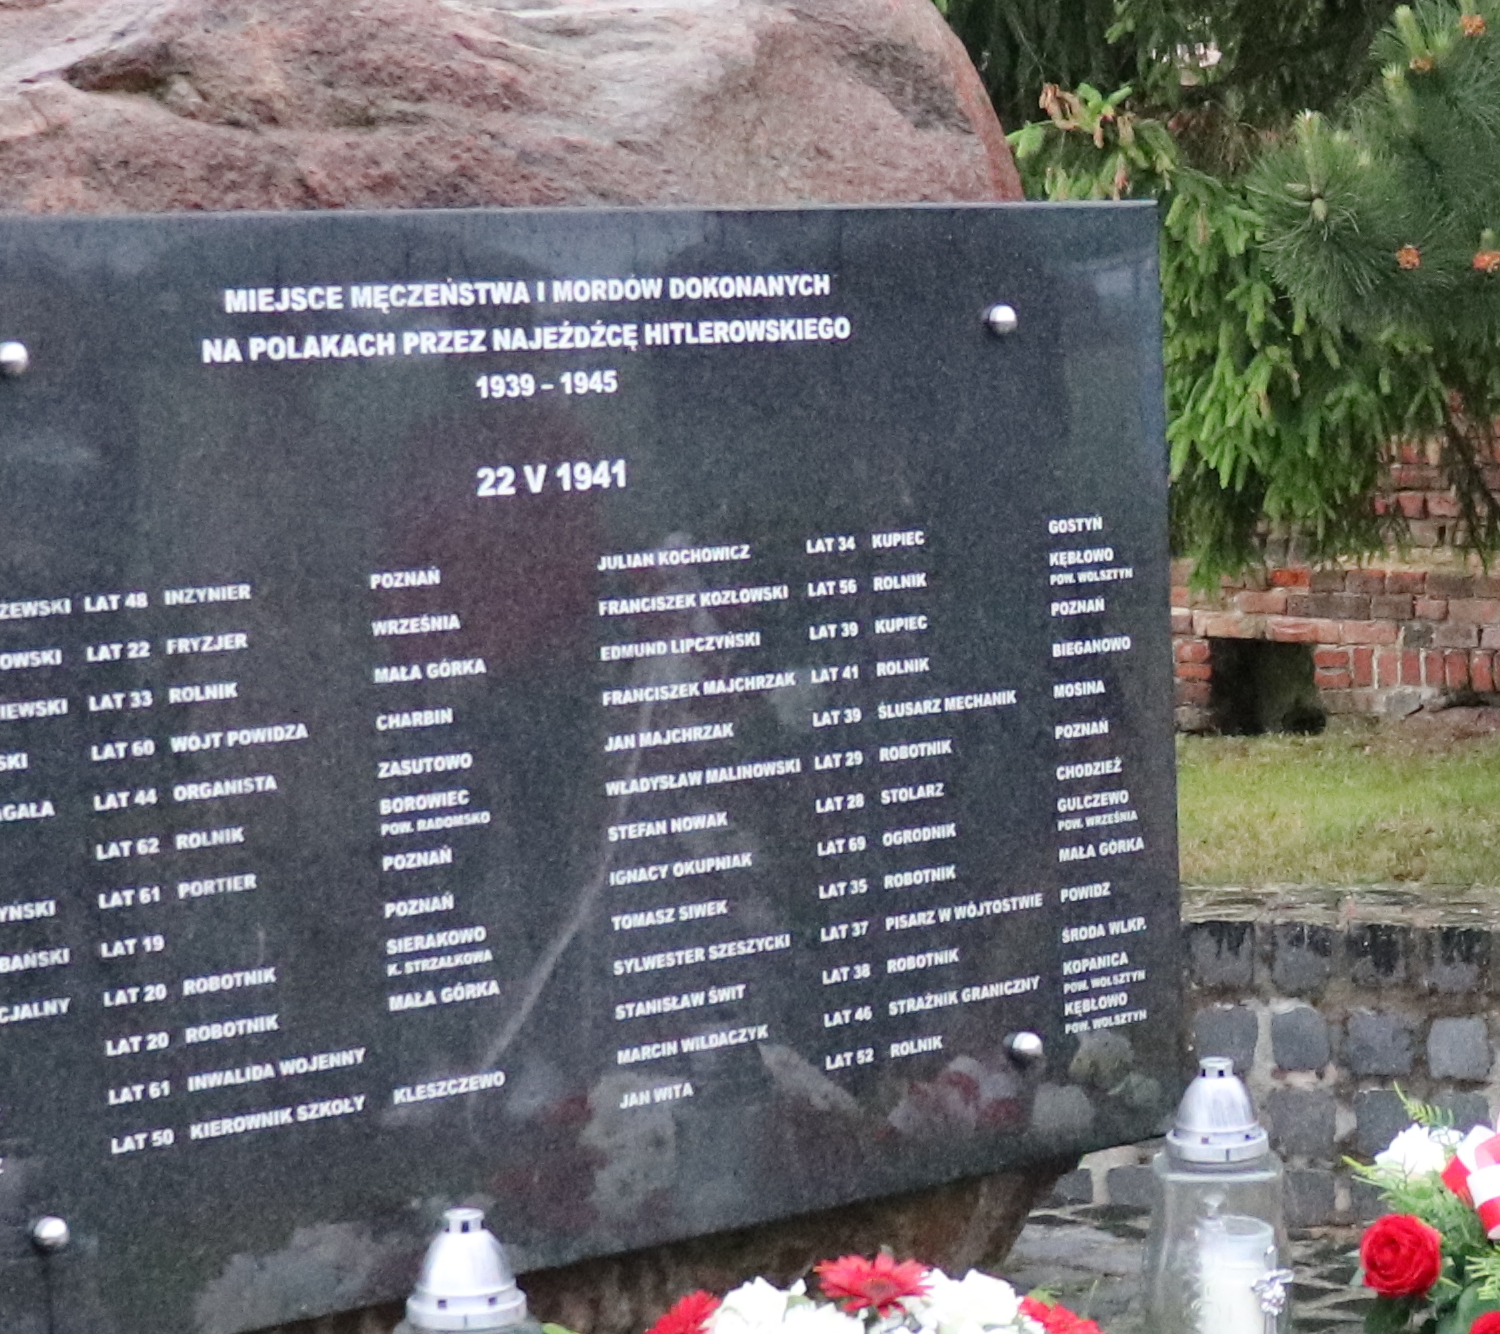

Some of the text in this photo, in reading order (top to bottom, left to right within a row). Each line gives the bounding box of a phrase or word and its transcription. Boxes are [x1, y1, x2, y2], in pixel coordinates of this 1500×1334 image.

[224, 273, 829, 314] MIEJSCE MĘCZEŃSTWA I MORDÓW DOKONANYCH
[202, 316, 850, 363] NA POLAKACH PRZEZ NAJEŹDŹCĘ HITLEROWSKIEGO
[475, 369, 617, 398] 1939 1945
[476, 458, 625, 496] 22 V 1941
[597, 530, 924, 570] JULIAN KOCHOWICZ LAT 34 KUPIEC
[84, 594, 120, 611] LAT
[124, 591, 148, 608] 48
[370, 565, 440, 589] POZNAŃ
[598, 572, 926, 615] FRANCISZEK KOZŁOWSKI LAT 56 ROLNIK
[86, 643, 122, 661] LAT
[127, 640, 150, 658] 22
[166, 632, 247, 654] FRYZJER
[600, 597, 1104, 661] EDMUND LIPCZYŃSKI LAT 39 KUPIEC POZNAŃ
[88, 692, 125, 711] LAT
[129, 689, 152, 708] 33
[168, 682, 237, 703] ROLNIK
[602, 635, 1130, 706] FRANCISZEK MAJCHRZAK LAT 41 ROLNIK BIEGANOWO
[91, 741, 127, 761] LAT
[131, 739, 154, 756] 60
[226, 723, 308, 746] POWIDZA
[604, 679, 1105, 751] JAN MAJCHRZAK LAT 39 ŚLUSARZ MECHANIK MOSINA
[93, 791, 129, 810] LAT
[134, 788, 157, 805] 44
[173, 774, 277, 801] ORGANISTA
[377, 752, 472, 778] ZASUTOWO
[605, 720, 1108, 796] WŁADYSŁAW MALINOWSKI LAT 29 ROBOTNIK POZNAŃ
[95, 840, 132, 860] LAT
[136, 837, 159, 855] 62
[175, 826, 244, 849] ROLNIK
[379, 789, 469, 815] BOROWIEC
[607, 782, 944, 841] STEFAN NOWAK LAT 28 STOLARZ
[609, 789, 1128, 885] IGNACY OKUPNIAK LAT 69 OGRODNIK GULCZEWO
[1085, 810, 1137, 827] WRZEŚNIA
[98, 889, 134, 909] LAT
[138, 885, 159, 904] 61
[177, 873, 256, 899] PORTIER
[382, 845, 452, 871] POZNAŃ
[611, 864, 955, 930] TOMASZ SIWEK LAT 35 ROBOTNIK
[100, 938, 137, 957] LAT
[142, 934, 164, 952] 19
[384, 891, 453, 918] POZNAŃ
[613, 881, 1110, 975] SYLWESTER SZESZYCKI LAT 37 PISARZ WÓJTOSTWIE POWIDZ
[103, 987, 139, 1006] LAT
[143, 983, 166, 1001] 20
[182, 966, 276, 995] ROBOTNIK
[386, 925, 486, 954] SIERAKOWO
[615, 947, 959, 1020] STANISŁAW LAT 38 ROBOTNIK
[105, 1035, 142, 1056] LAT
[146, 1031, 168, 1050] 20
[185, 1013, 278, 1043] ROBOTNIK
[617, 951, 1128, 1064] MARCIN LAT 46 GRANICZNY KOPANICA
[108, 1084, 144, 1105] LAT
[148, 1080, 169, 1098] 61
[187, 1063, 274, 1091] INWALIDA
[278, 1047, 365, 1075] WOJENNY
[619, 1035, 942, 1108] JAN WITA ROLNIK
[111, 1132, 147, 1154] LAT
[151, 1128, 173, 1146] 50
[190, 1107, 293, 1139] KIEROWNIK
[296, 1094, 364, 1121] SZKOŁY
[393, 1070, 504, 1104] KLESZCZEWO
